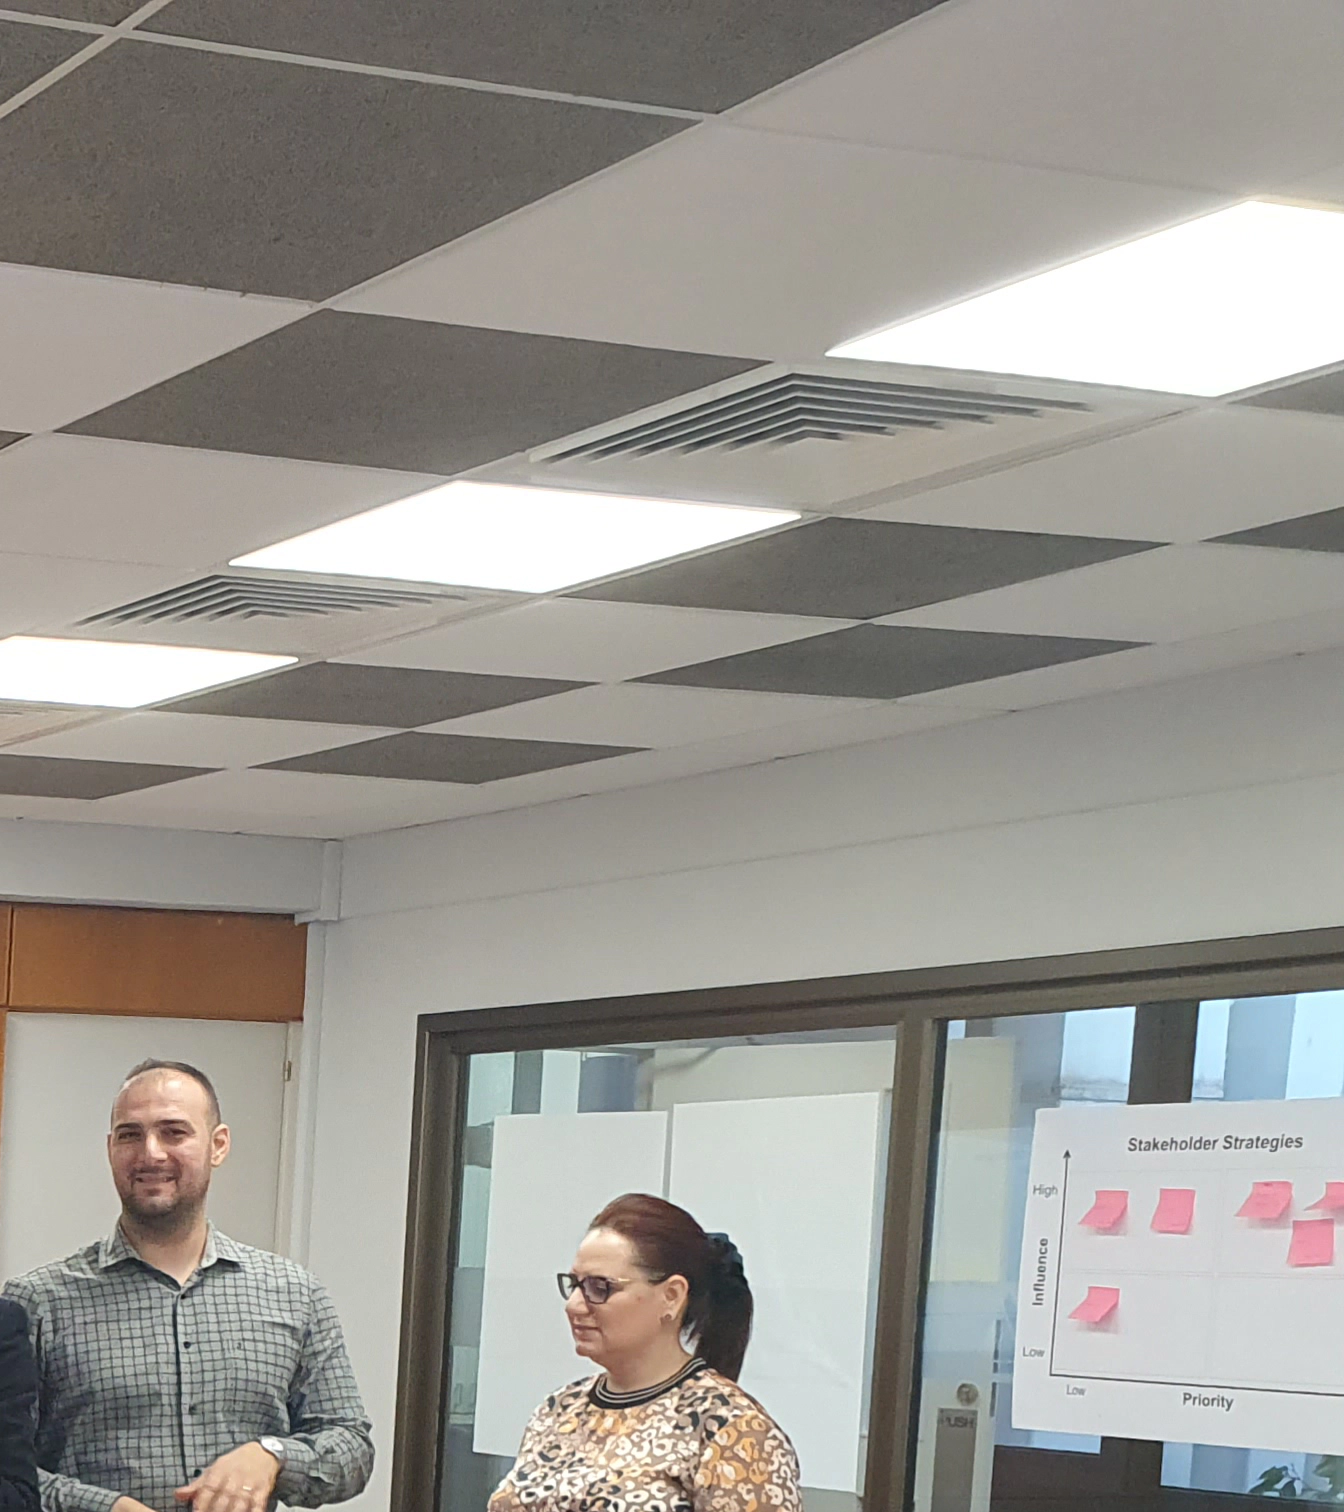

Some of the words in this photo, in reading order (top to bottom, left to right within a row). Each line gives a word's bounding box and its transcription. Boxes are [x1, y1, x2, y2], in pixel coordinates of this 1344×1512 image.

[1127, 1136, 1219, 1152] Stakeholder
[1222, 1133, 1304, 1153] Strategies
[1032, 1184, 1058, 1197] High
[1032, 1238, 1049, 1306] Influence
[1022, 1347, 1045, 1358] Low
[1066, 1385, 1086, 1396] Low
[1182, 1392, 1234, 1412] Priority
